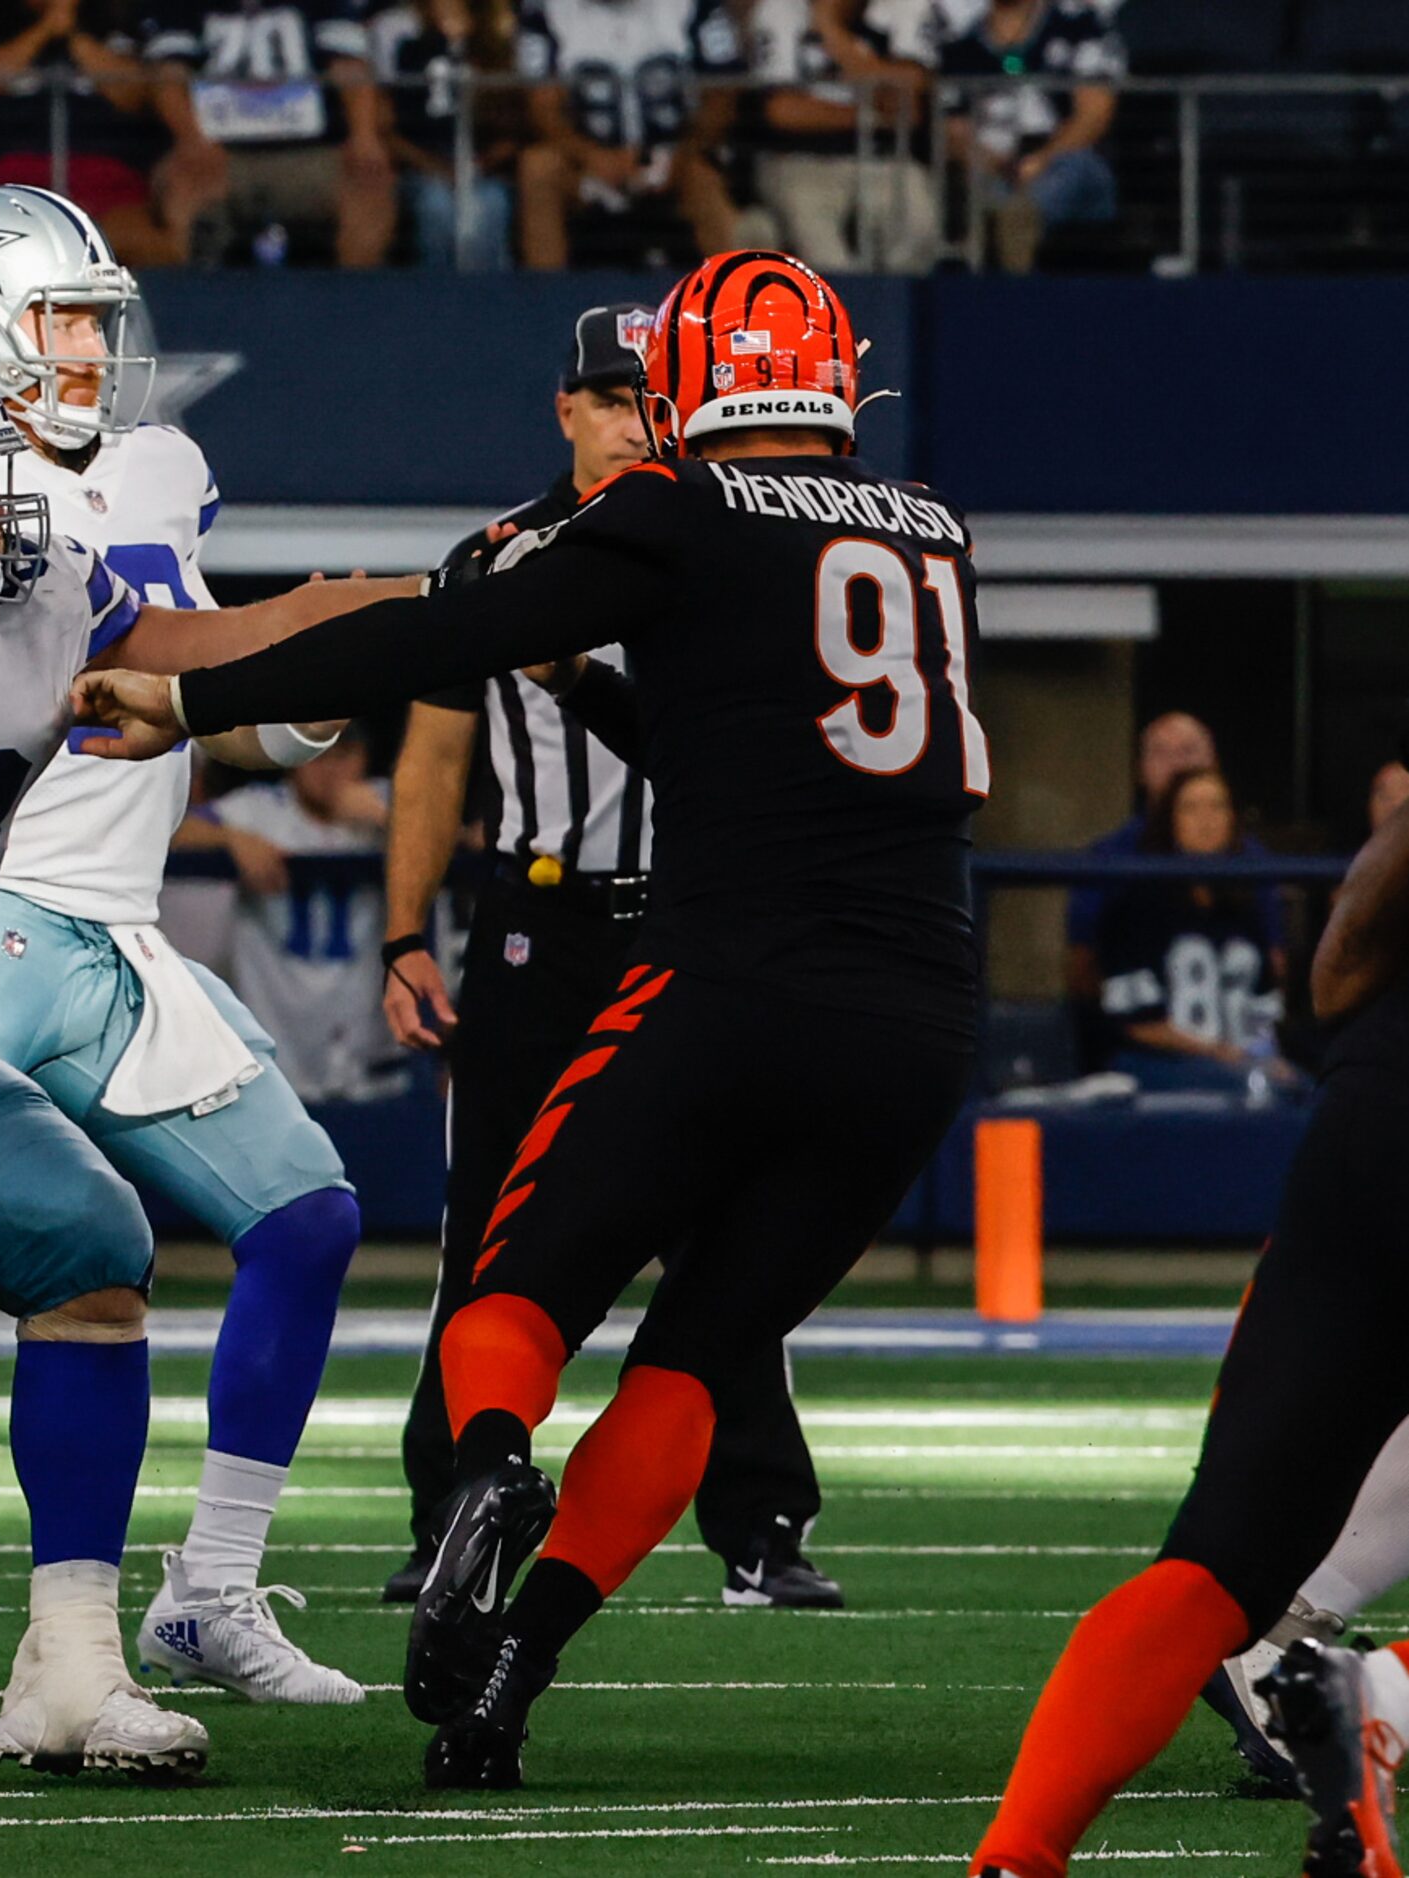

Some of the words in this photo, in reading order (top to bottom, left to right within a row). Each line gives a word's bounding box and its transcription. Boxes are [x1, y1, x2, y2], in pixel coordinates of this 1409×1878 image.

[755, 355, 800, 388] 91
[721, 401, 834, 418] BENGALS
[707, 461, 965, 547] HENDRICKSO
[814, 536, 990, 798] 91
[154, 1625, 204, 1663] adidas
